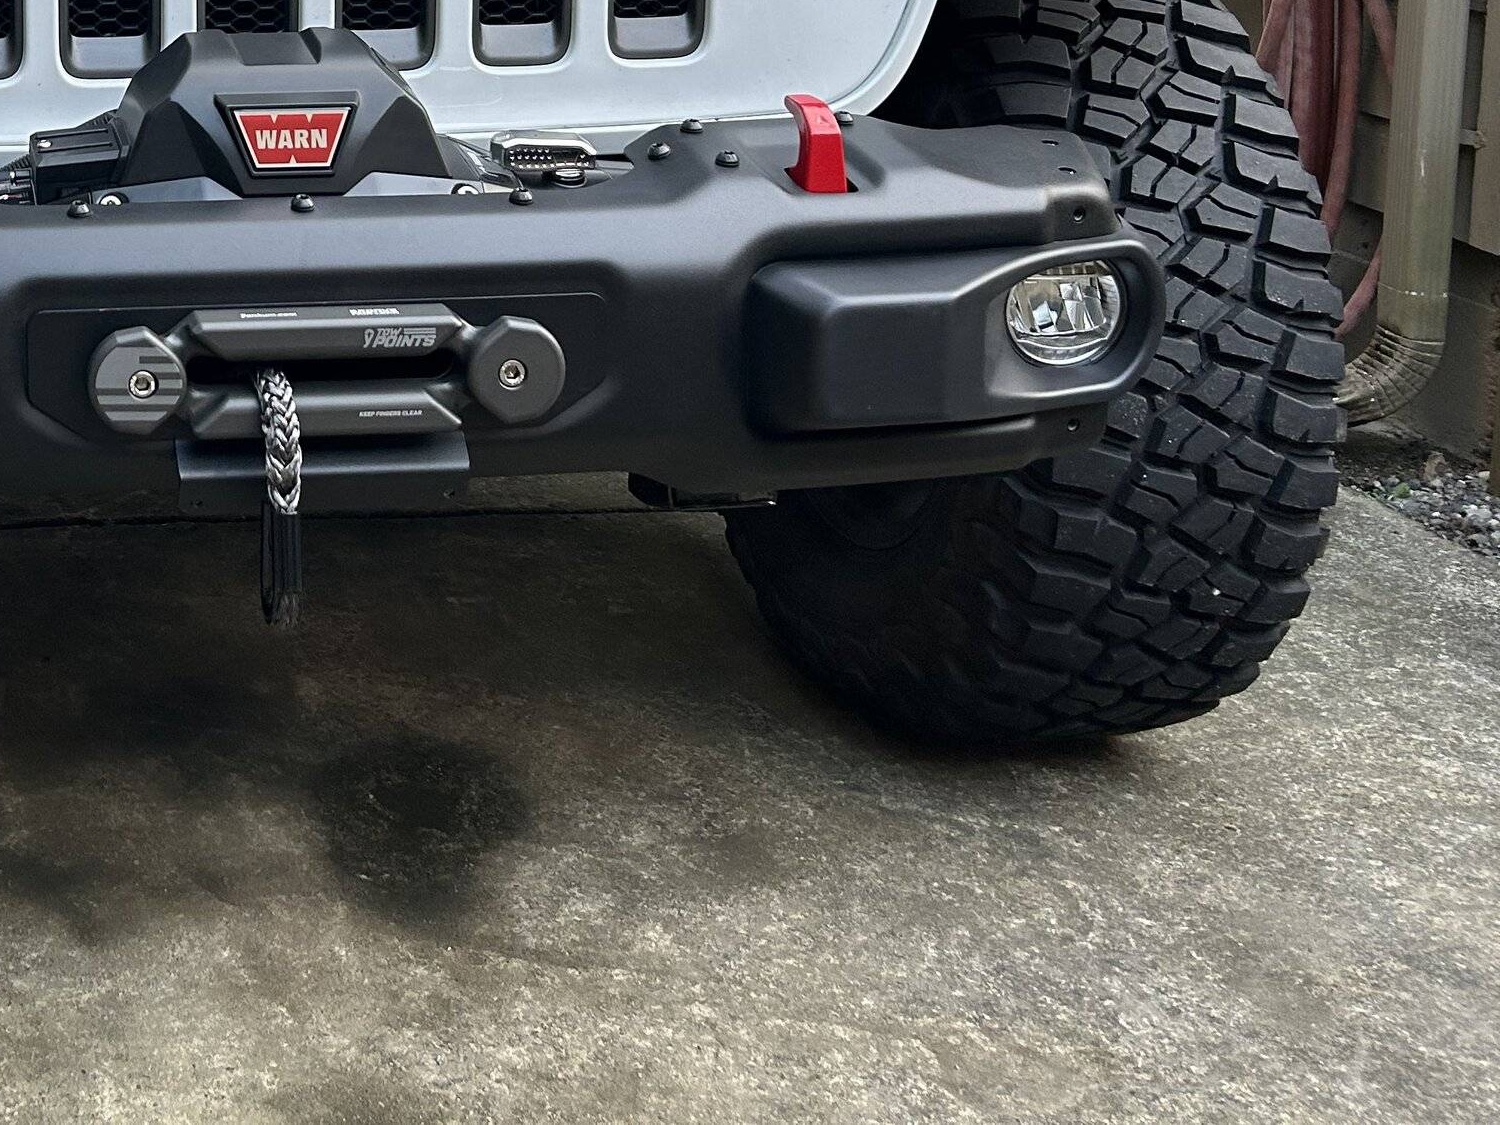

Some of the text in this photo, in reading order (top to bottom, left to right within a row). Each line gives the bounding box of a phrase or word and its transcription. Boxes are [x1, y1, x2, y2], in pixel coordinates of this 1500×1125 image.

[255, 128, 328, 150] WARN
[377, 328, 402, 336] TOW
[372, 335, 436, 347] POINTS
